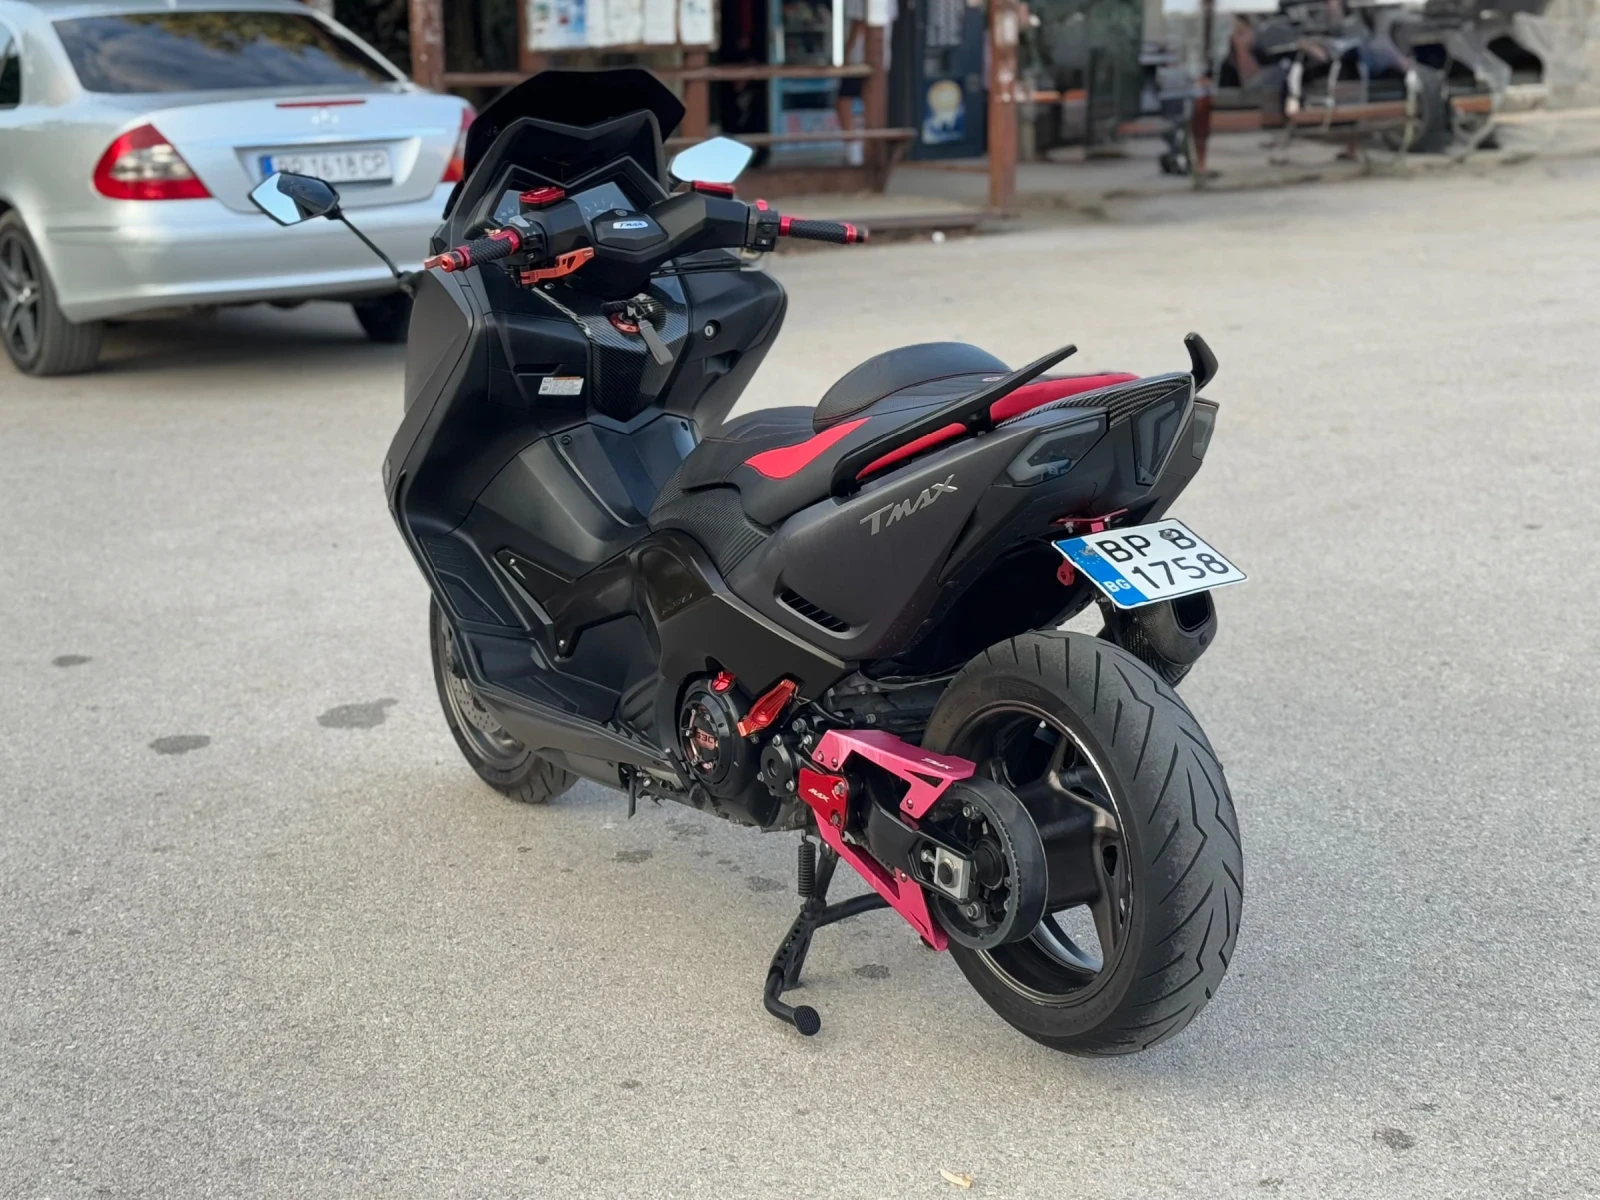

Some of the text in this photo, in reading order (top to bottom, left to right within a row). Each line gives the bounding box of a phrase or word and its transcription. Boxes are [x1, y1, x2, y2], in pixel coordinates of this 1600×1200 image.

[859, 473, 958, 536] TMAX
[1095, 534, 1151, 563] BP
[1102, 578, 1132, 594] BG
[1131, 553, 1229, 589] 1758
